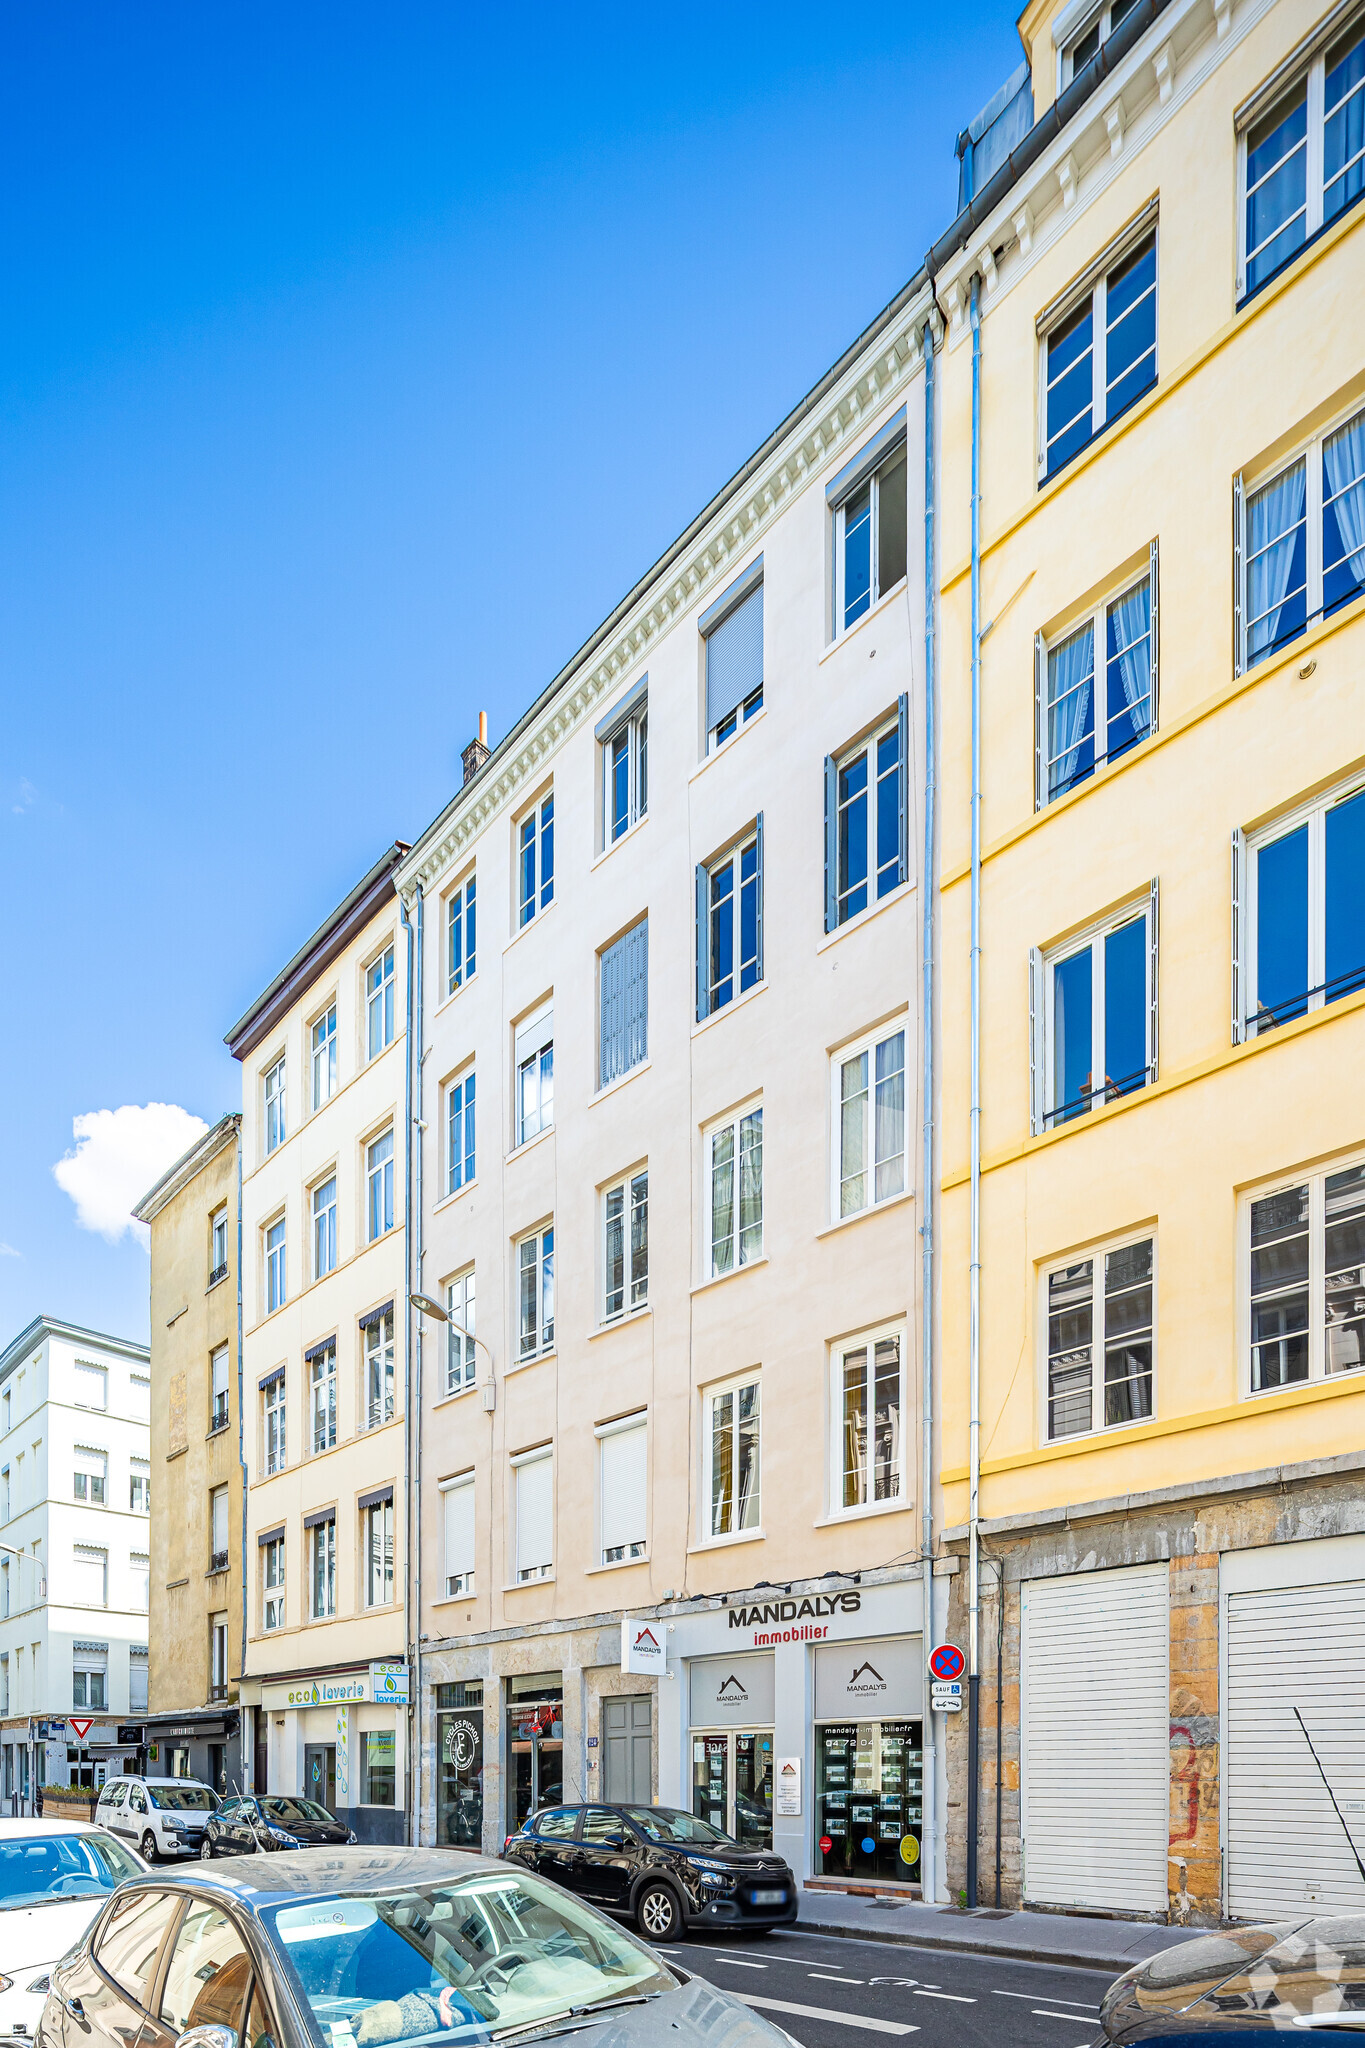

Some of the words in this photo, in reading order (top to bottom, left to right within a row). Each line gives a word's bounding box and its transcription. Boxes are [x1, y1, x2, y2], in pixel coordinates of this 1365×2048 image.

[728, 1591, 861, 1628] MANDALYS
[754, 1625, 828, 1646] immobilier
[632, 1645, 661, 1654] MANDALYS
[380, 1664, 402, 1673] eco
[288, 1690, 310, 1703] eco
[322, 1681, 364, 1700] laverie
[846, 1683, 887, 1692] MANDALYS
[376, 1694, 406, 1703] laverie
[445, 1720, 462, 1744] CYCLES
[462, 1720, 480, 1744] PICHON
